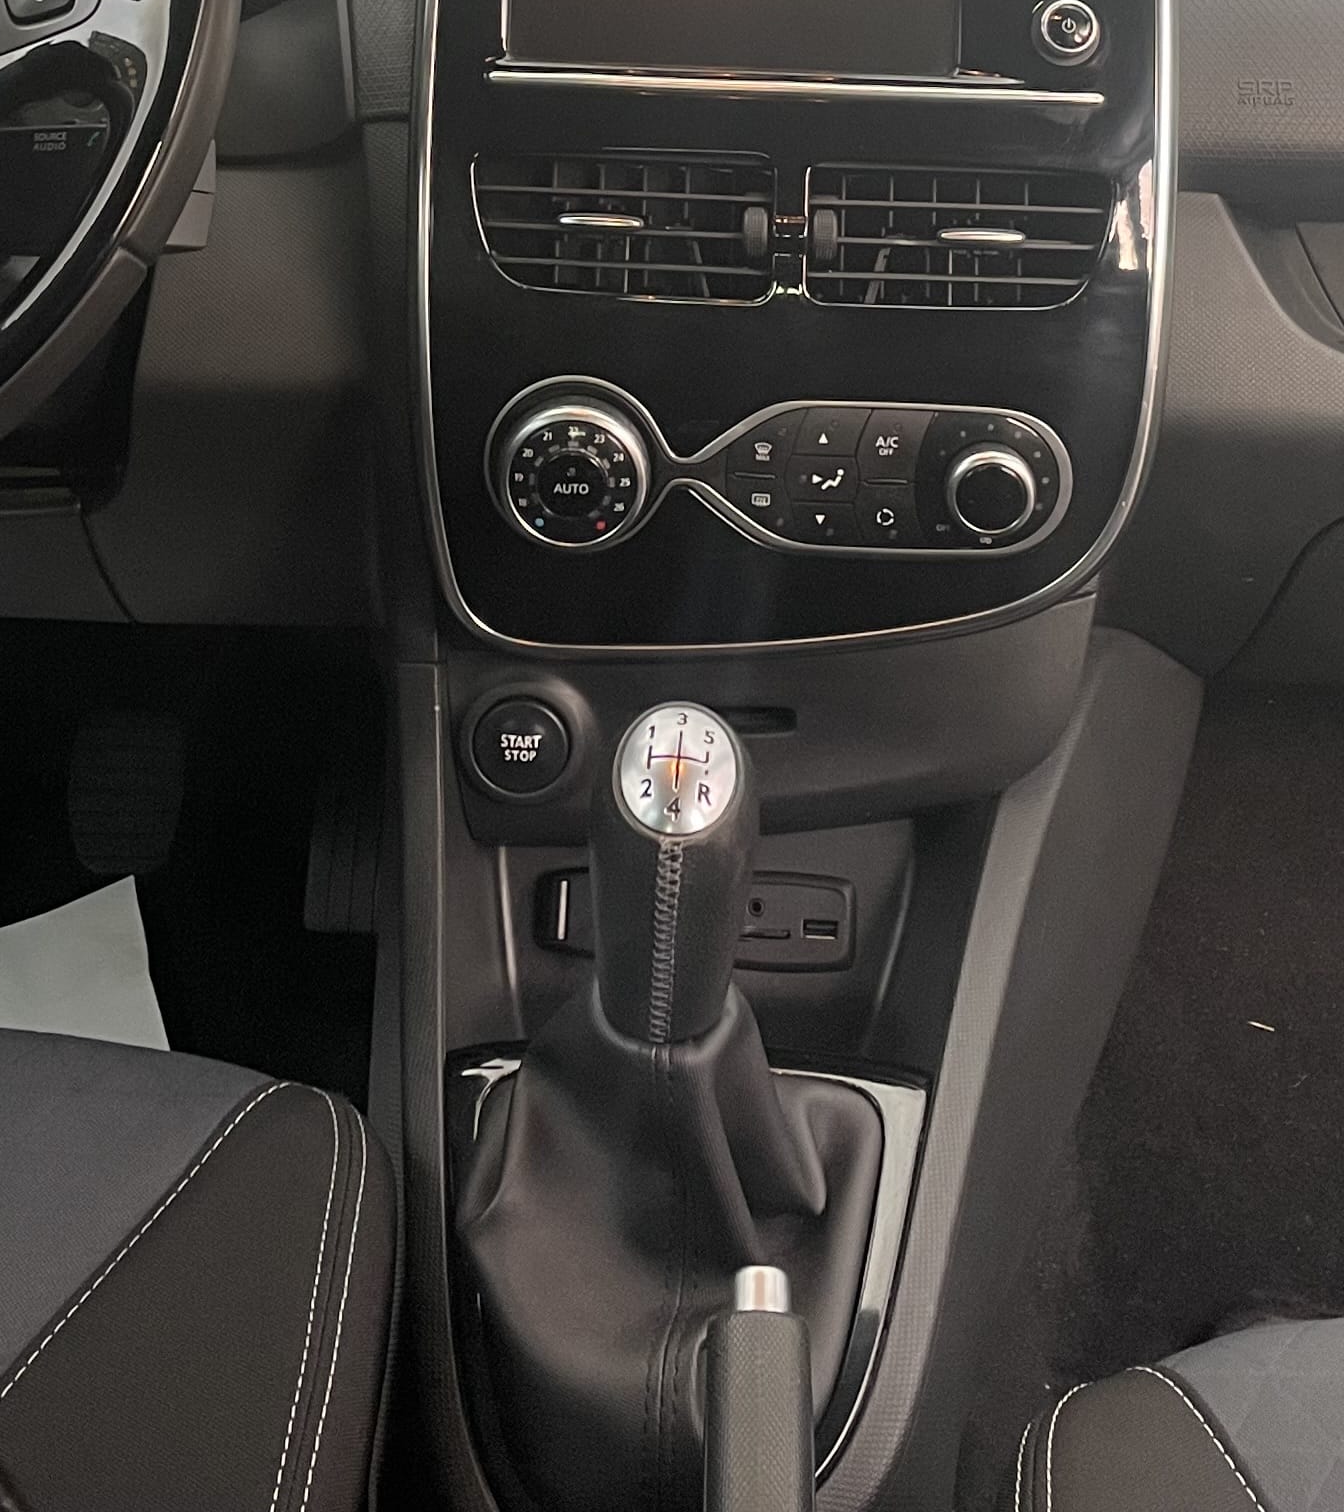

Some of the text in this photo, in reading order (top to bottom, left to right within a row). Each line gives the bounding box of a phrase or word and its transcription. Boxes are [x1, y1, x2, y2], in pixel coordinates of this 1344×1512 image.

[32, 141, 67, 152] AUDIO
[542, 431, 553, 441] 21
[593, 434, 606, 444] 23
[875, 436, 900, 448] A/C
[522, 448, 534, 458] 20
[613, 452, 625, 463] 24
[878, 448, 894, 456] OFF
[619, 477, 631, 487] 25
[553, 483, 590, 494] AUTO
[676, 712, 688, 726] 3
[648, 724, 656, 739] 1
[703, 730, 716, 745] 5
[500, 733, 543, 749] START
[504, 749, 537, 762] STOP
[639, 778, 653, 799] 2
[697, 782, 712, 807] R
[664, 796, 681, 822] 4
